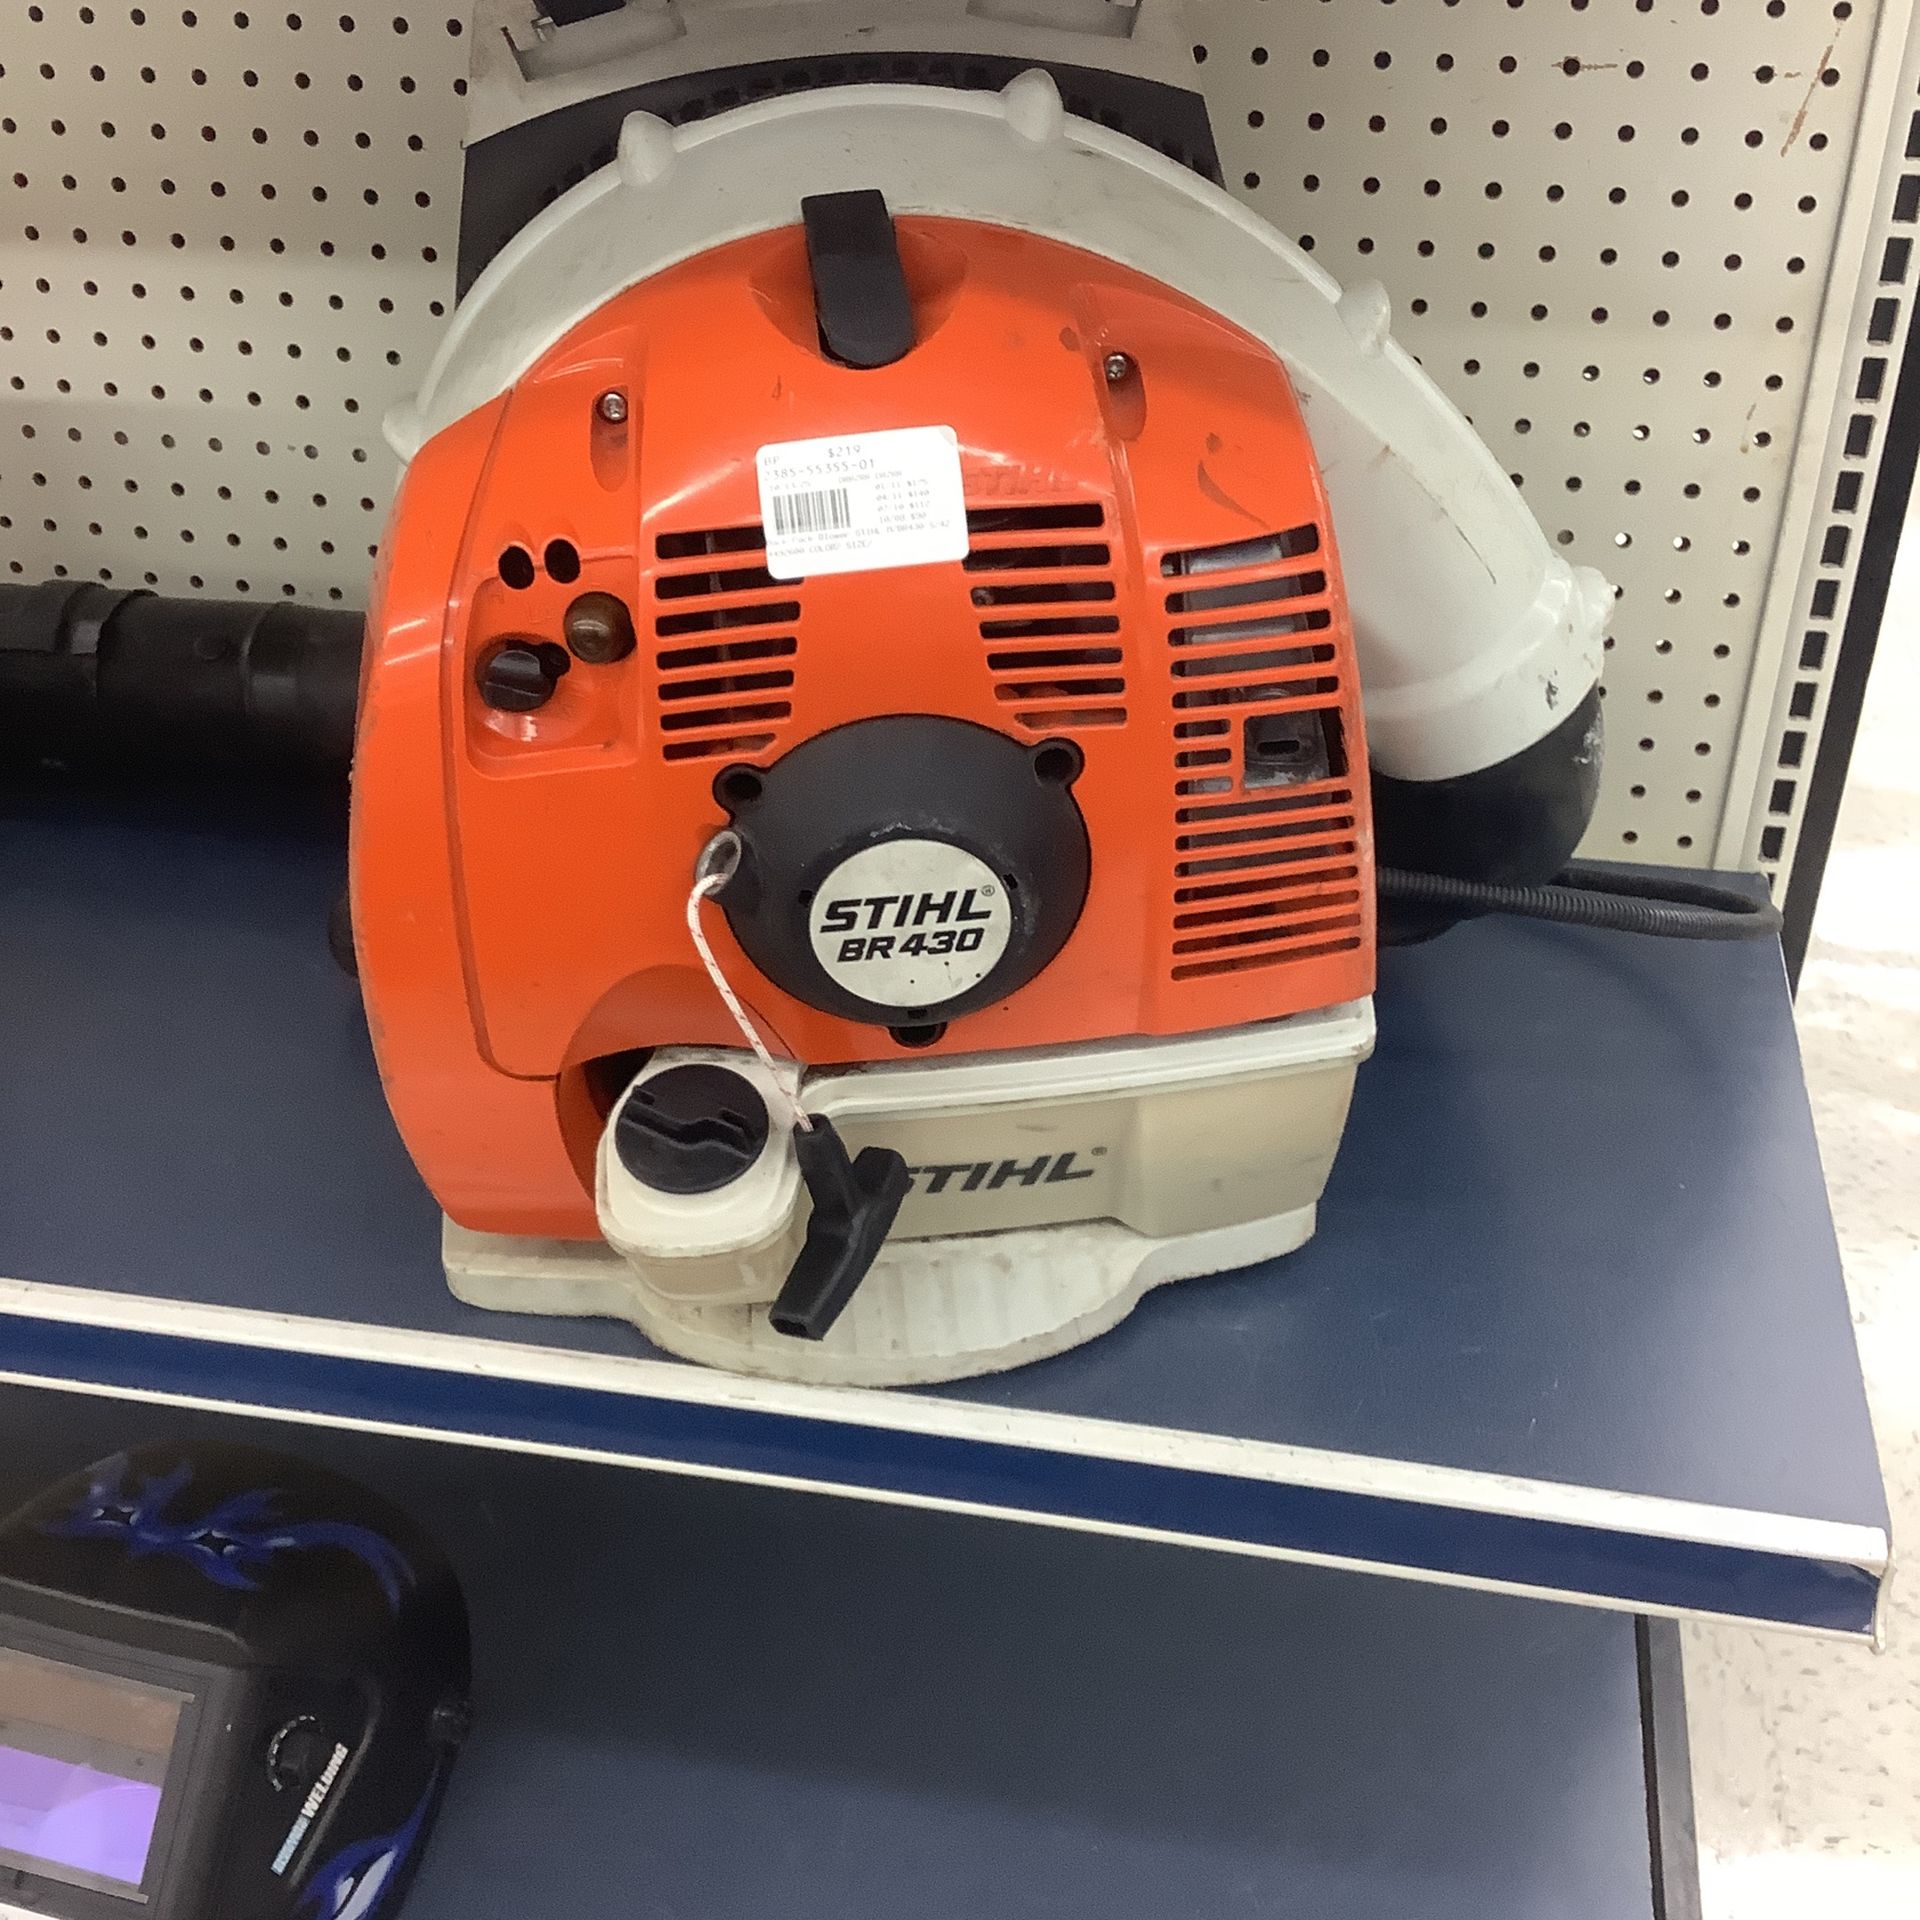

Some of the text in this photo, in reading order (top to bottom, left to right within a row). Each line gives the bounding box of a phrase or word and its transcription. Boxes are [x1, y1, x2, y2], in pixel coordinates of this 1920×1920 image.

[828, 444, 861, 459] $219
[818, 531, 848, 542] Blower
[907, 1151, 1095, 1194] TIHL
